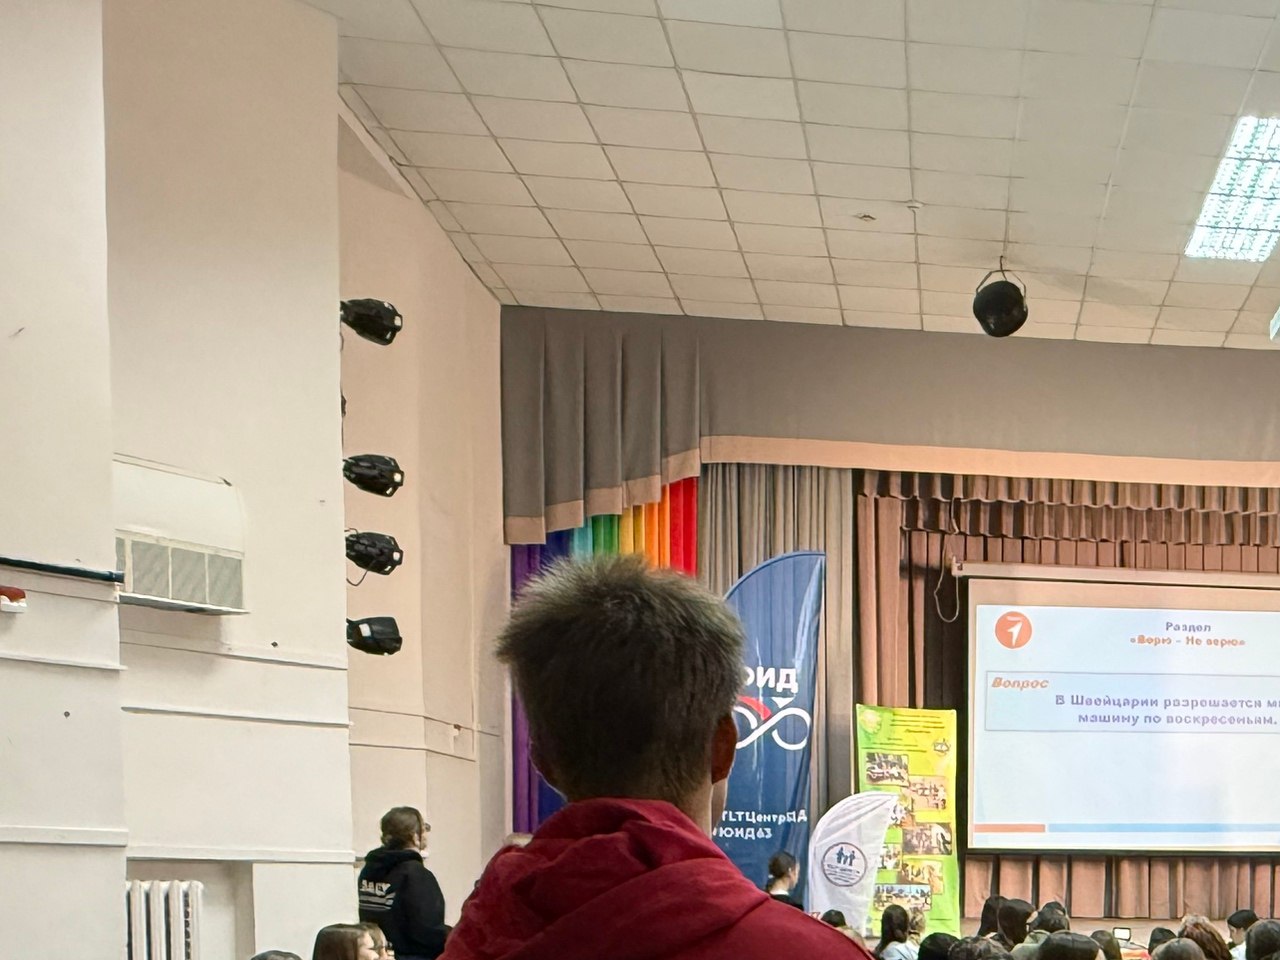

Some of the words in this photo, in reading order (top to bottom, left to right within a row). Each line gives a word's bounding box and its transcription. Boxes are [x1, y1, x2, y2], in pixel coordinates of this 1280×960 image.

[1165, 621, 1212, 634] Раздел
[991, 677, 1049, 691] Вопрос
[1055, 694, 1066, 706] В
[1070, 694, 1159, 709] Швейцарии
[1163, 696, 1262, 711] разрешается
[1078, 713, 1140, 727] машину
[1144, 714, 1162, 724] по
